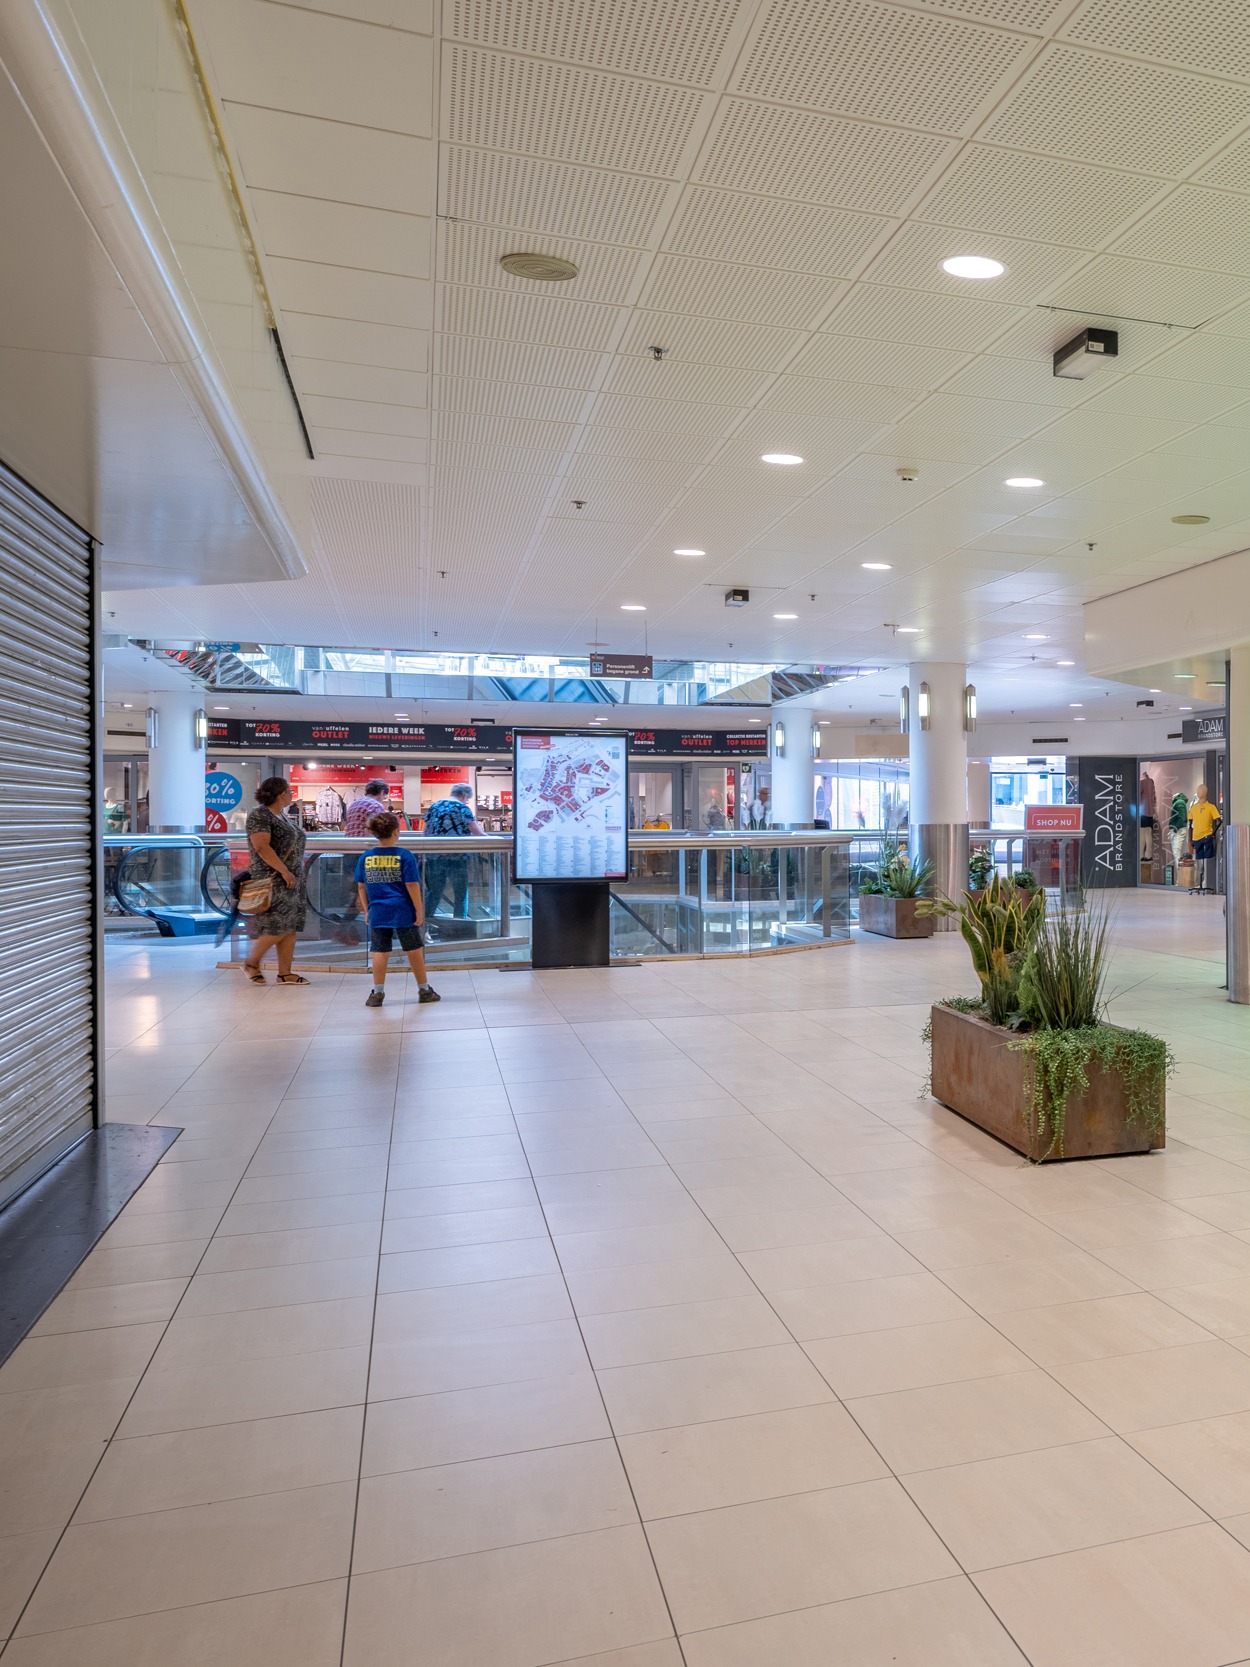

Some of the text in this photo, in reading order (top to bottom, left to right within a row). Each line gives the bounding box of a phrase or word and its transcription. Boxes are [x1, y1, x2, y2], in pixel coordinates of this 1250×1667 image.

[255, 723, 280, 733] 70%
[369, 726, 399, 734] IEDERE
[1198, 719, 1223, 733] ADAM
[312, 730, 349, 739] OUTLET
[454, 728, 477, 737] 70%
[634, 732, 655, 741] 70%
[1095, 774, 1123, 871] ADAM BRANDSTORE
[365, 855, 402, 869] SONIC
